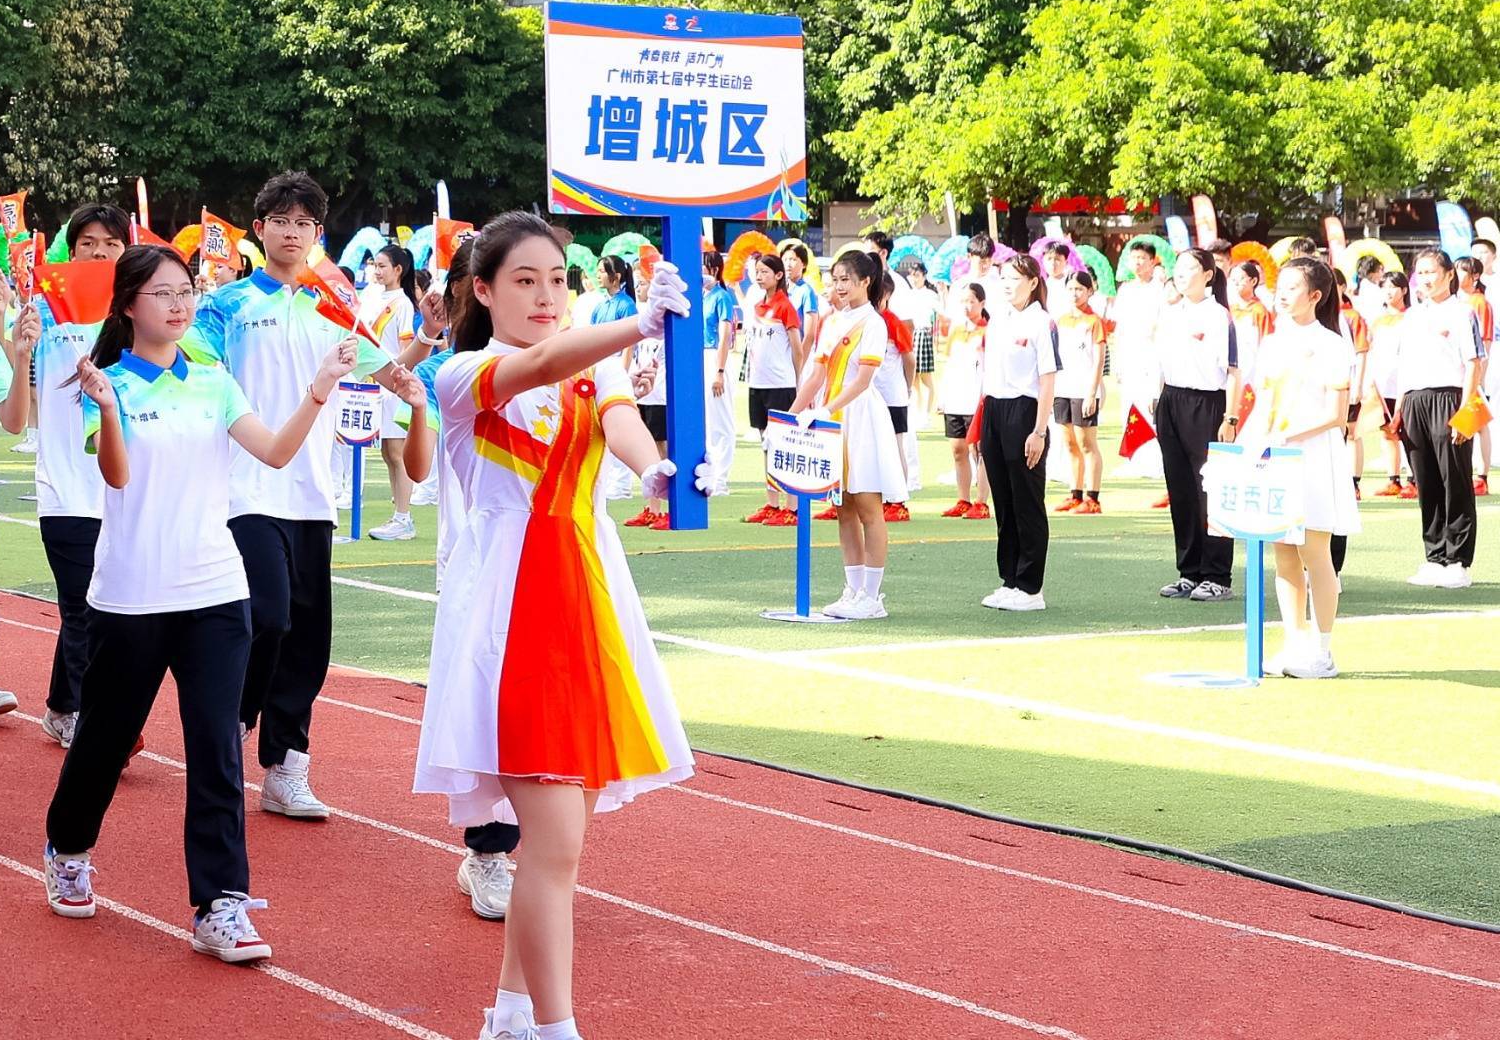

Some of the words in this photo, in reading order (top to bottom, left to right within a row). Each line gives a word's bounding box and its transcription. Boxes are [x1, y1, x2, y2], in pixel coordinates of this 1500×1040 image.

[606, 68, 753, 90] 广州市第七届中学生运动会
[584, 95, 768, 167] 增城区
[341, 408, 373, 430] 荔湾区
[774, 449, 831, 480] 裁判员代表
[1221, 485, 1286, 515] 越秀区
